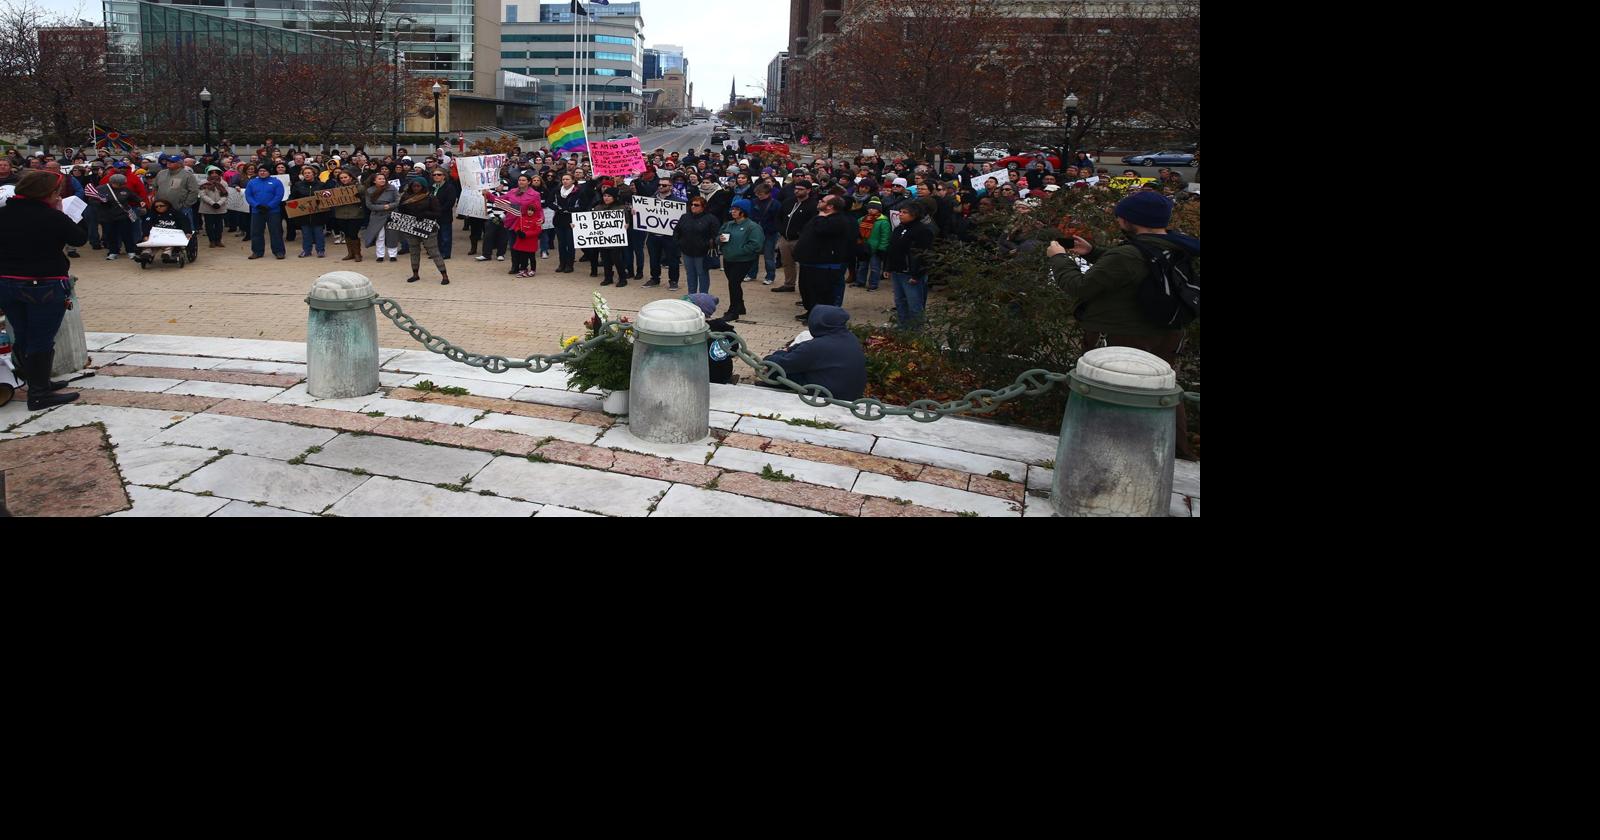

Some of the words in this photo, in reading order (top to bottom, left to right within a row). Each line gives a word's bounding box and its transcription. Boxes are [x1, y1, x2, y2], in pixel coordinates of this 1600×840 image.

[632, 196, 649, 205] WE
[654, 198, 686, 211] FIGHT
[591, 210, 624, 220] DIVERSITY
[646, 207, 669, 215] with
[594, 219, 624, 230] BEAUTY
[577, 233, 626, 246] STRENGTH
